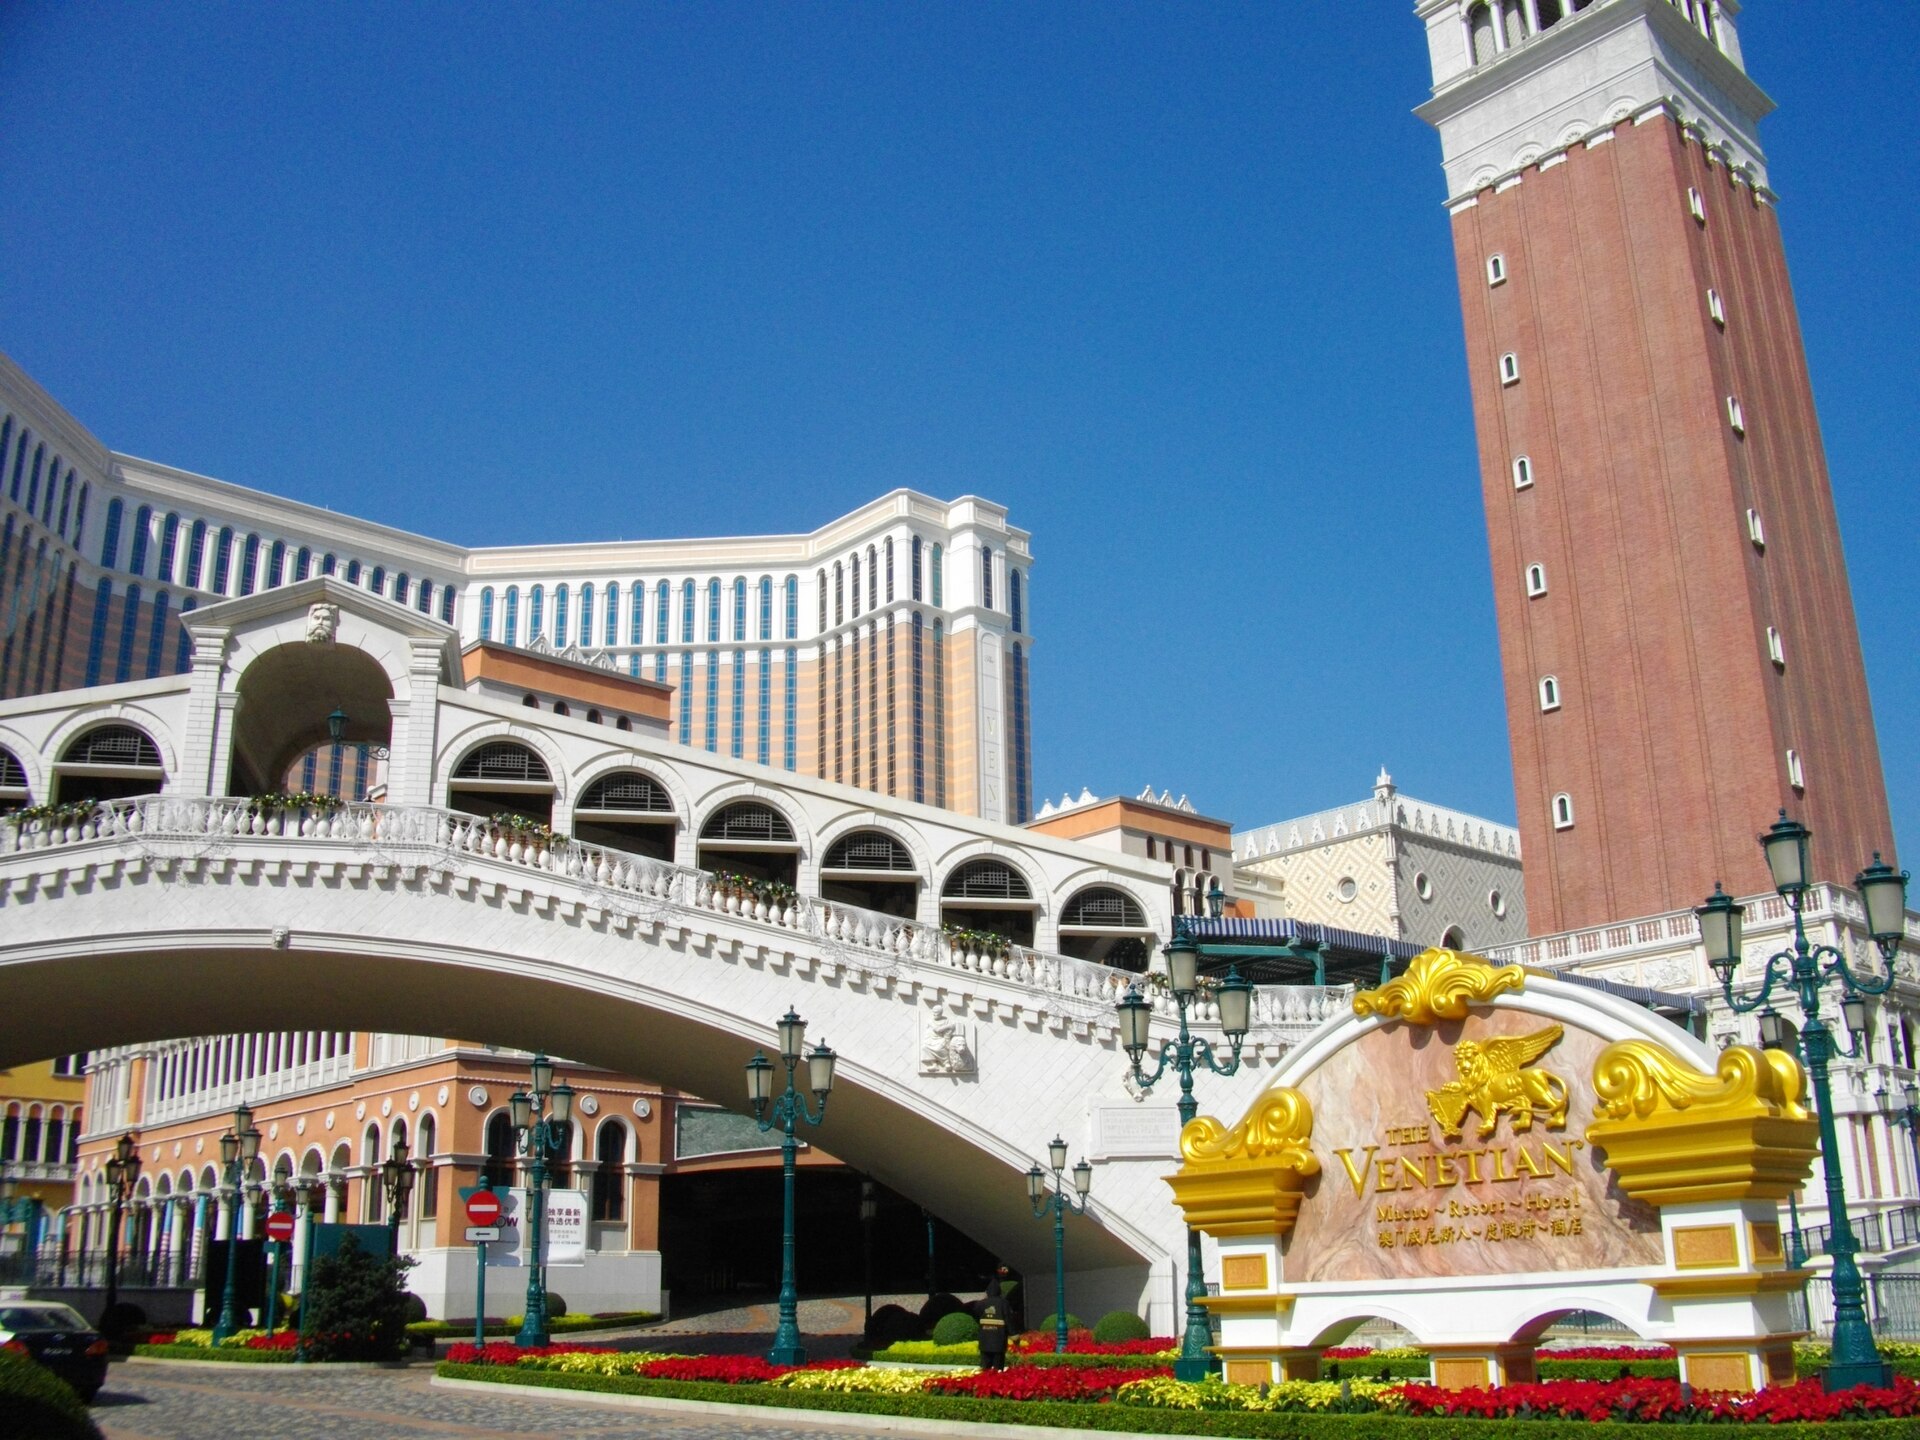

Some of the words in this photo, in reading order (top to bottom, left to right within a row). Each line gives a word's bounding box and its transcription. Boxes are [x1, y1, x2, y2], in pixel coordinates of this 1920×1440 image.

[986, 715, 998, 822] VEN
[1385, 1125, 1430, 1146] THE
[1376, 1204, 1429, 1222] Macao
[1448, 1199, 1505, 1217] Resort
[1525, 1186, 1580, 1211] Hotel
